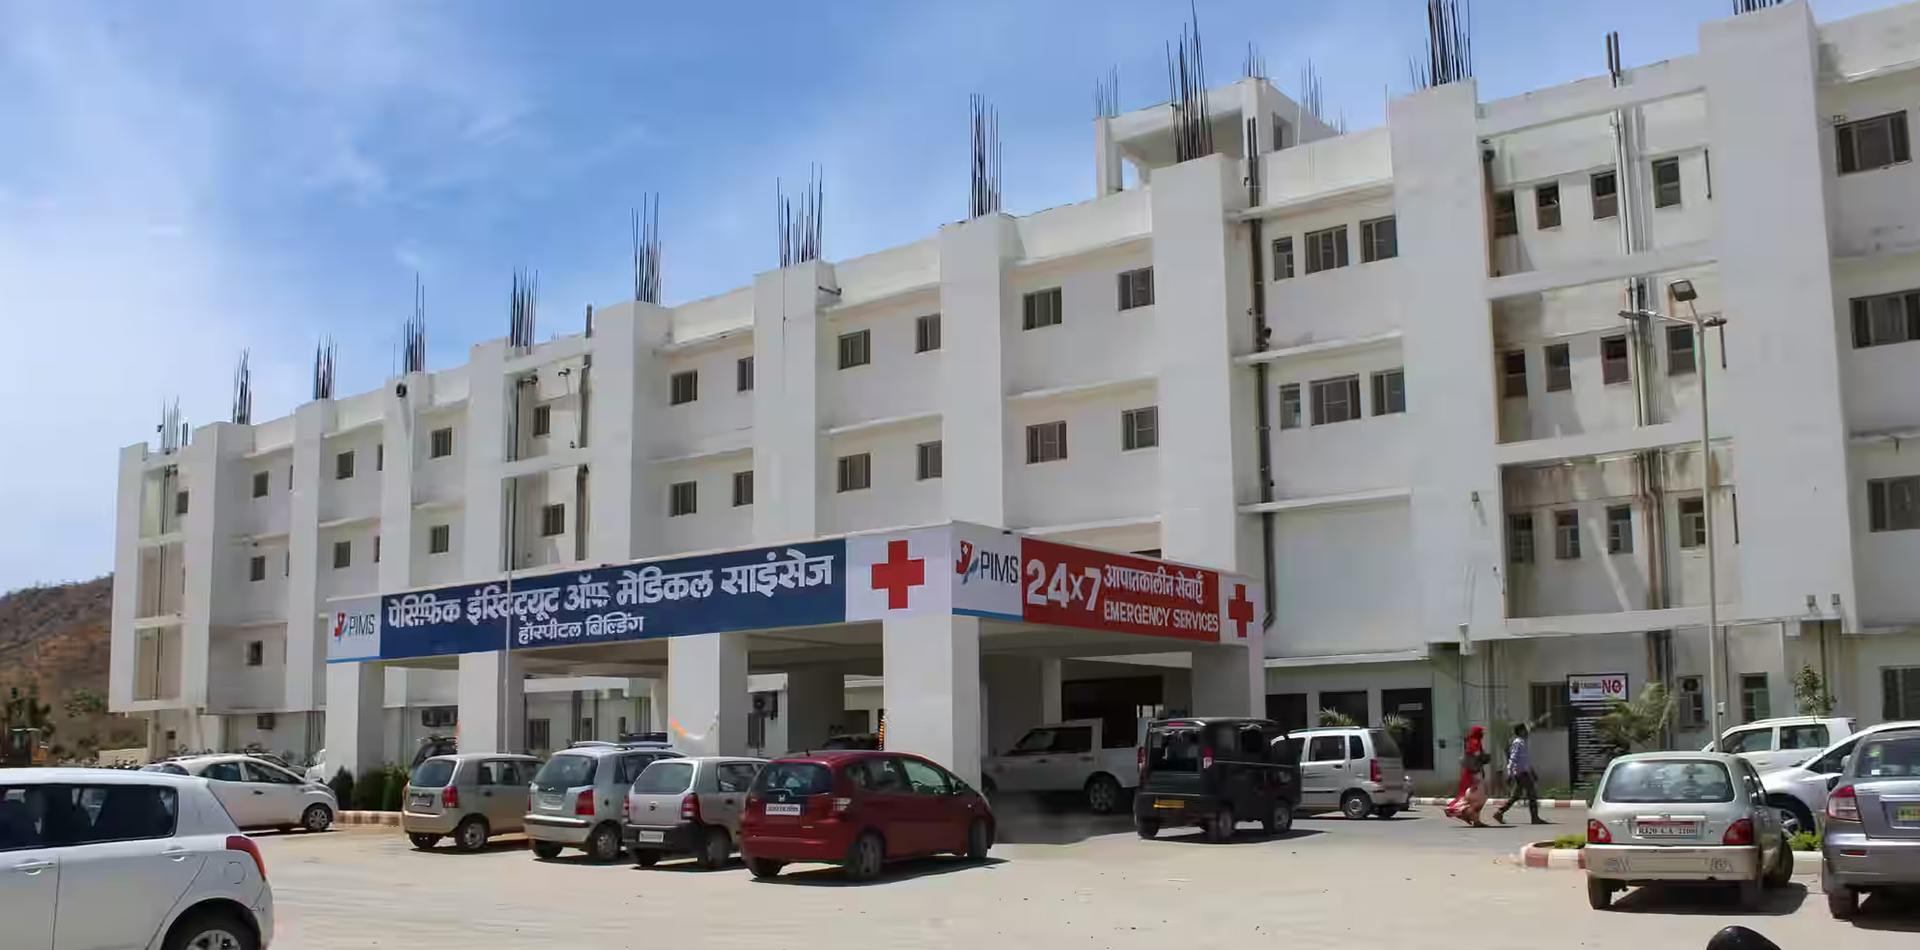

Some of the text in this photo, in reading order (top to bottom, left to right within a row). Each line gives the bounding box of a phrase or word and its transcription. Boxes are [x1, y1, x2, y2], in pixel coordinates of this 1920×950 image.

[564, 573, 611, 611] ऑफ
[616, 566, 714, 606] मेडिकल
[721, 548, 834, 598] साइंसेज
[981, 549, 1019, 585] PIMS
[1104, 564, 1173, 597] आपातकालीन
[350, 612, 375, 637] PIMS
[518, 611, 644, 645] हॉस्पीटल बिल्डिंग
[1104, 600, 1219, 632] EMERGENCY SERVICES
